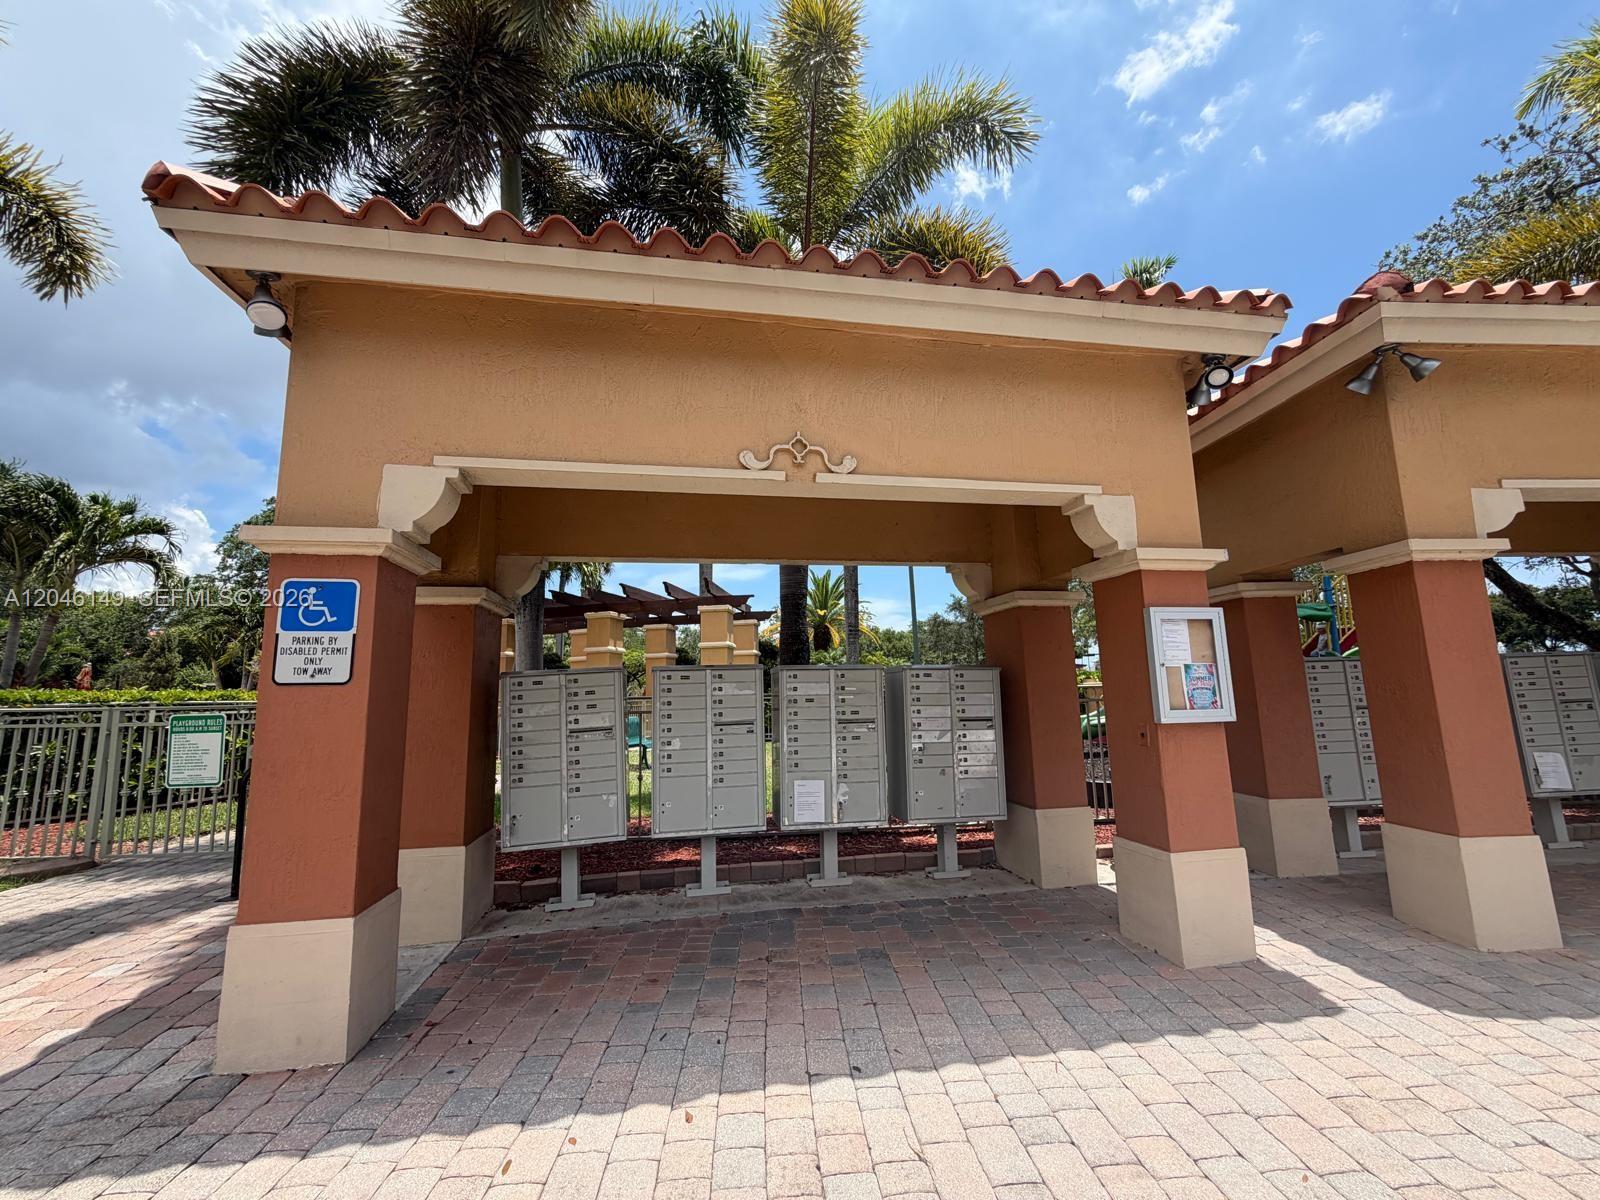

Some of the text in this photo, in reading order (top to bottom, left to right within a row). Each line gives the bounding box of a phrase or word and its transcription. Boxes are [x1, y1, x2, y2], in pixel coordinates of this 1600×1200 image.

[291, 636, 339, 646] PARKING BY
[280, 646, 349, 656] DISABLED PERMIT
[303, 656, 323, 666] ONLY
[293, 667, 333, 676] TOW AWAY
